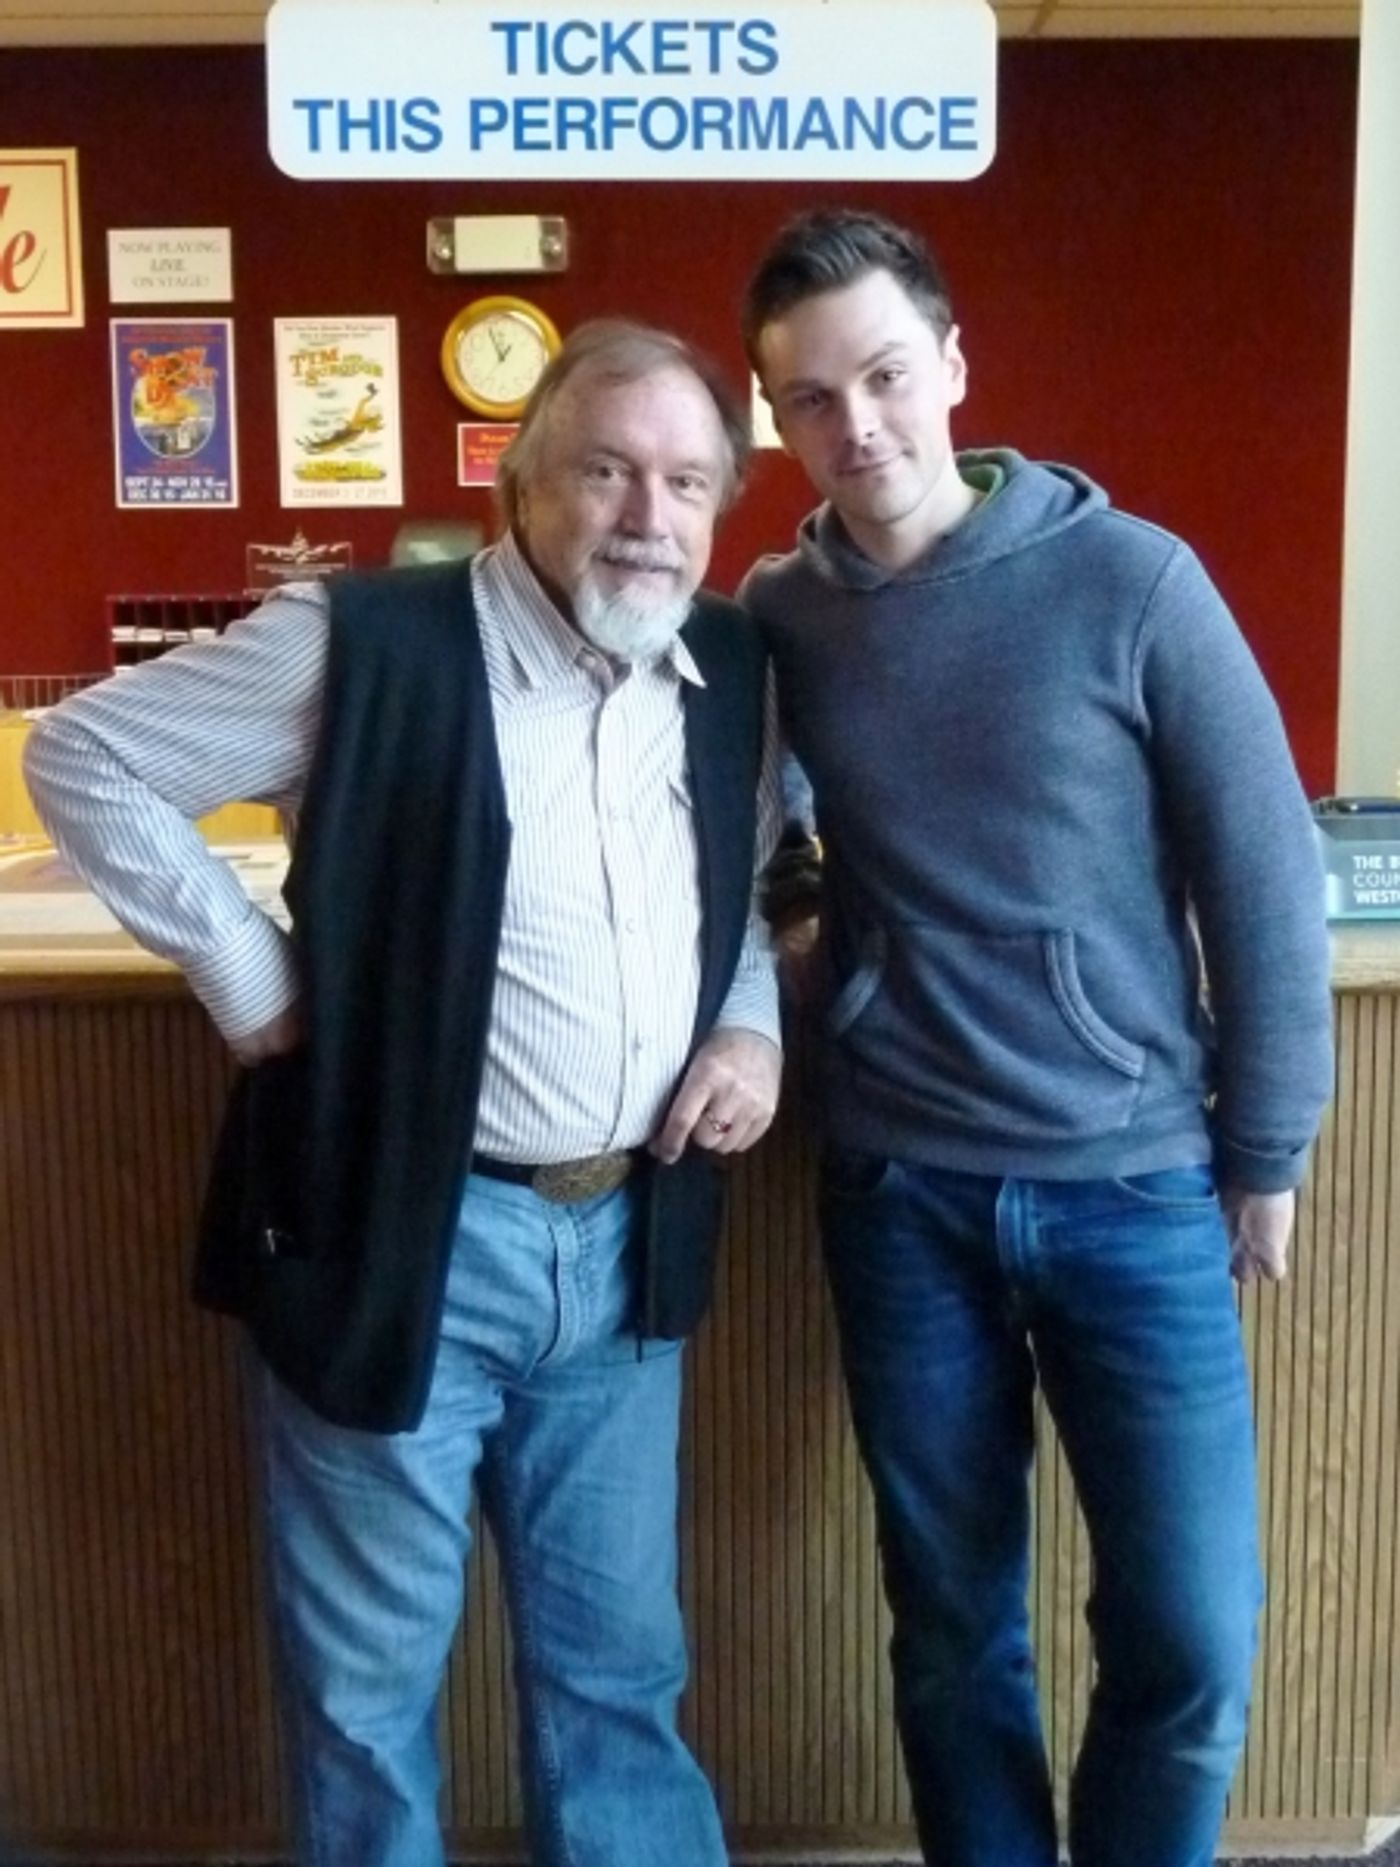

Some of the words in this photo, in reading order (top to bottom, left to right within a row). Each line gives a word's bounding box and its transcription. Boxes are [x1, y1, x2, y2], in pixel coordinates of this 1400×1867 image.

[491, 20, 778, 76] TICKETS
[293, 98, 442, 152] THIS
[469, 96, 978, 151] PERFORMANCE
[119, 241, 153, 254] NOW
[157, 240, 222, 254] PLAYING
[150, 258, 187, 272] LIVE
[131, 275, 153, 288] ON
[1353, 855, 1383, 870] THE
